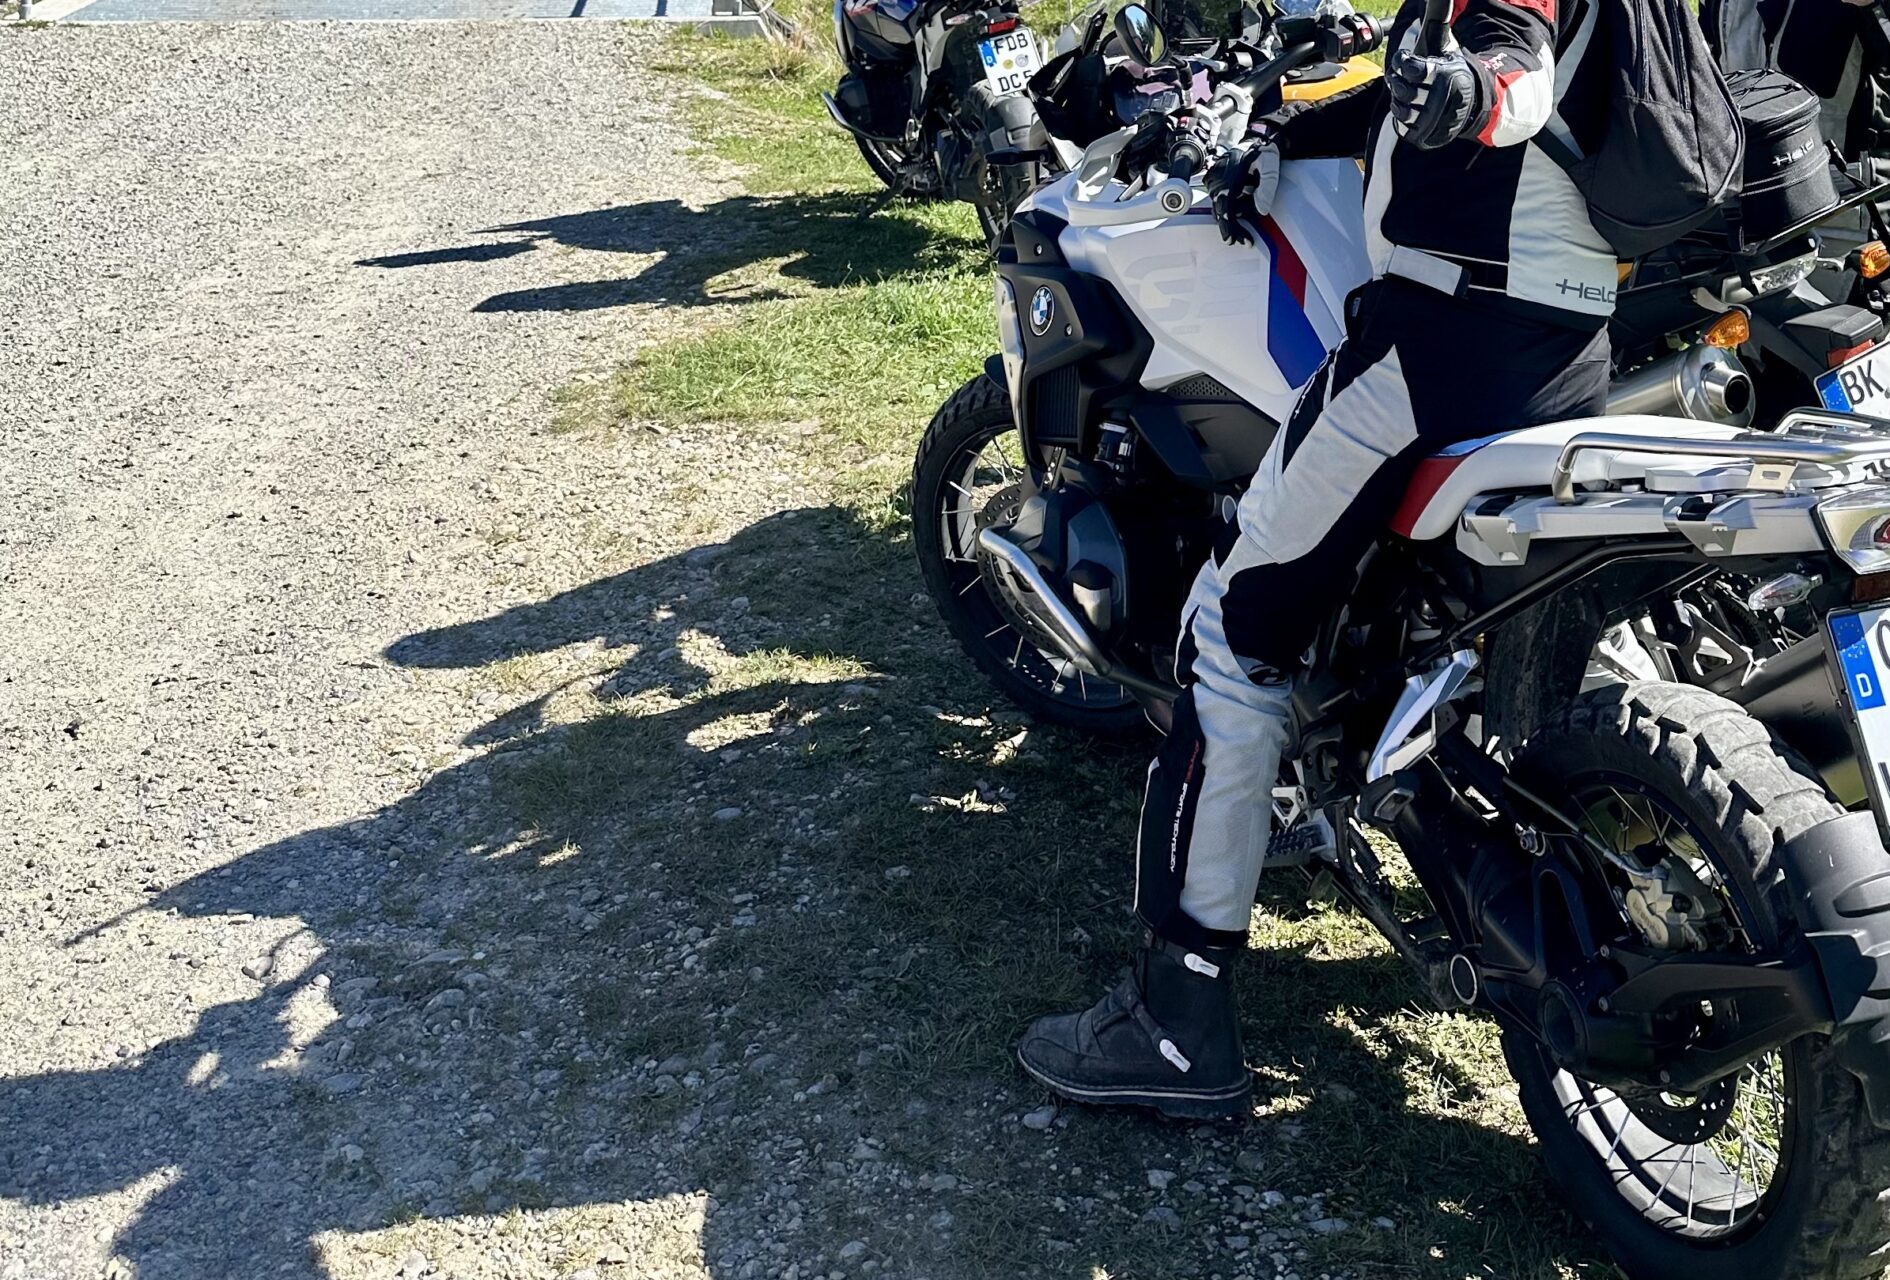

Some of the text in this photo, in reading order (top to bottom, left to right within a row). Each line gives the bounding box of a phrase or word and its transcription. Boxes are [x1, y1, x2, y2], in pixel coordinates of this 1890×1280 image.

[994, 32, 1029, 55] FDB
[998, 73, 1022, 92] DC
[1840, 359, 1884, 406] BK
[1856, 673, 1873, 697] D
